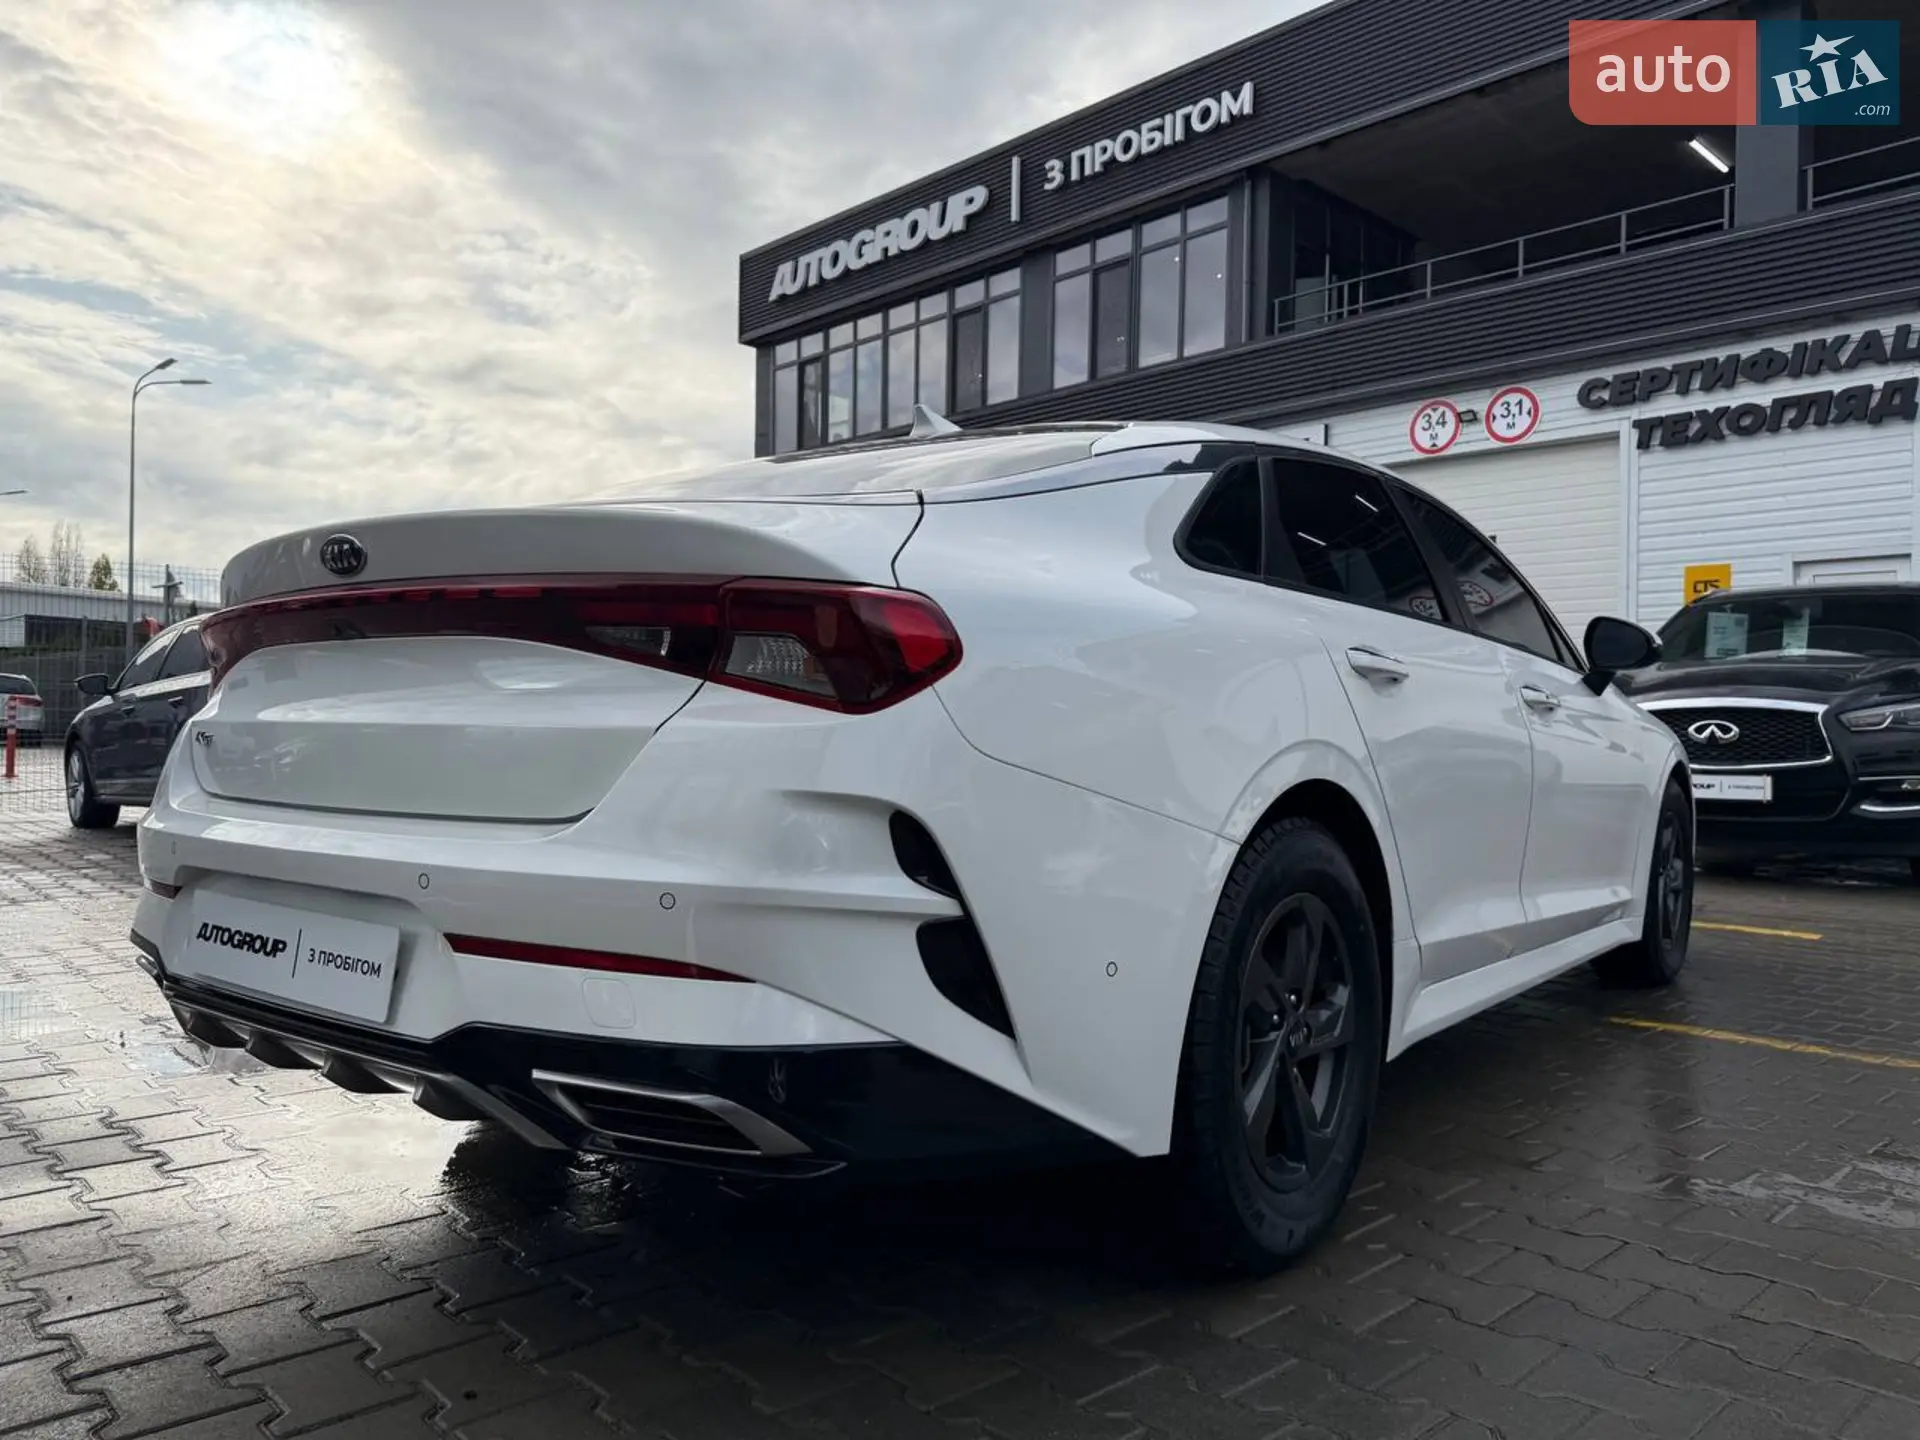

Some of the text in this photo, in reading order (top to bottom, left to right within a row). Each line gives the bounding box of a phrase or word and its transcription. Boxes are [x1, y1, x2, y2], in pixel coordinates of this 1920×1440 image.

[1070, 81, 1256, 181] ПРОБІГОМ
[768, 184, 989, 303] AUTOGROUP
[1421, 411, 1448, 432] 3,4
[1500, 398, 1524, 420] 3,1
[1632, 377, 1919, 450] ТЕХОГЛЯД
[196, 922, 288, 958] AUTOGROUP
[318, 950, 383, 979] ПРОБІГОМ
